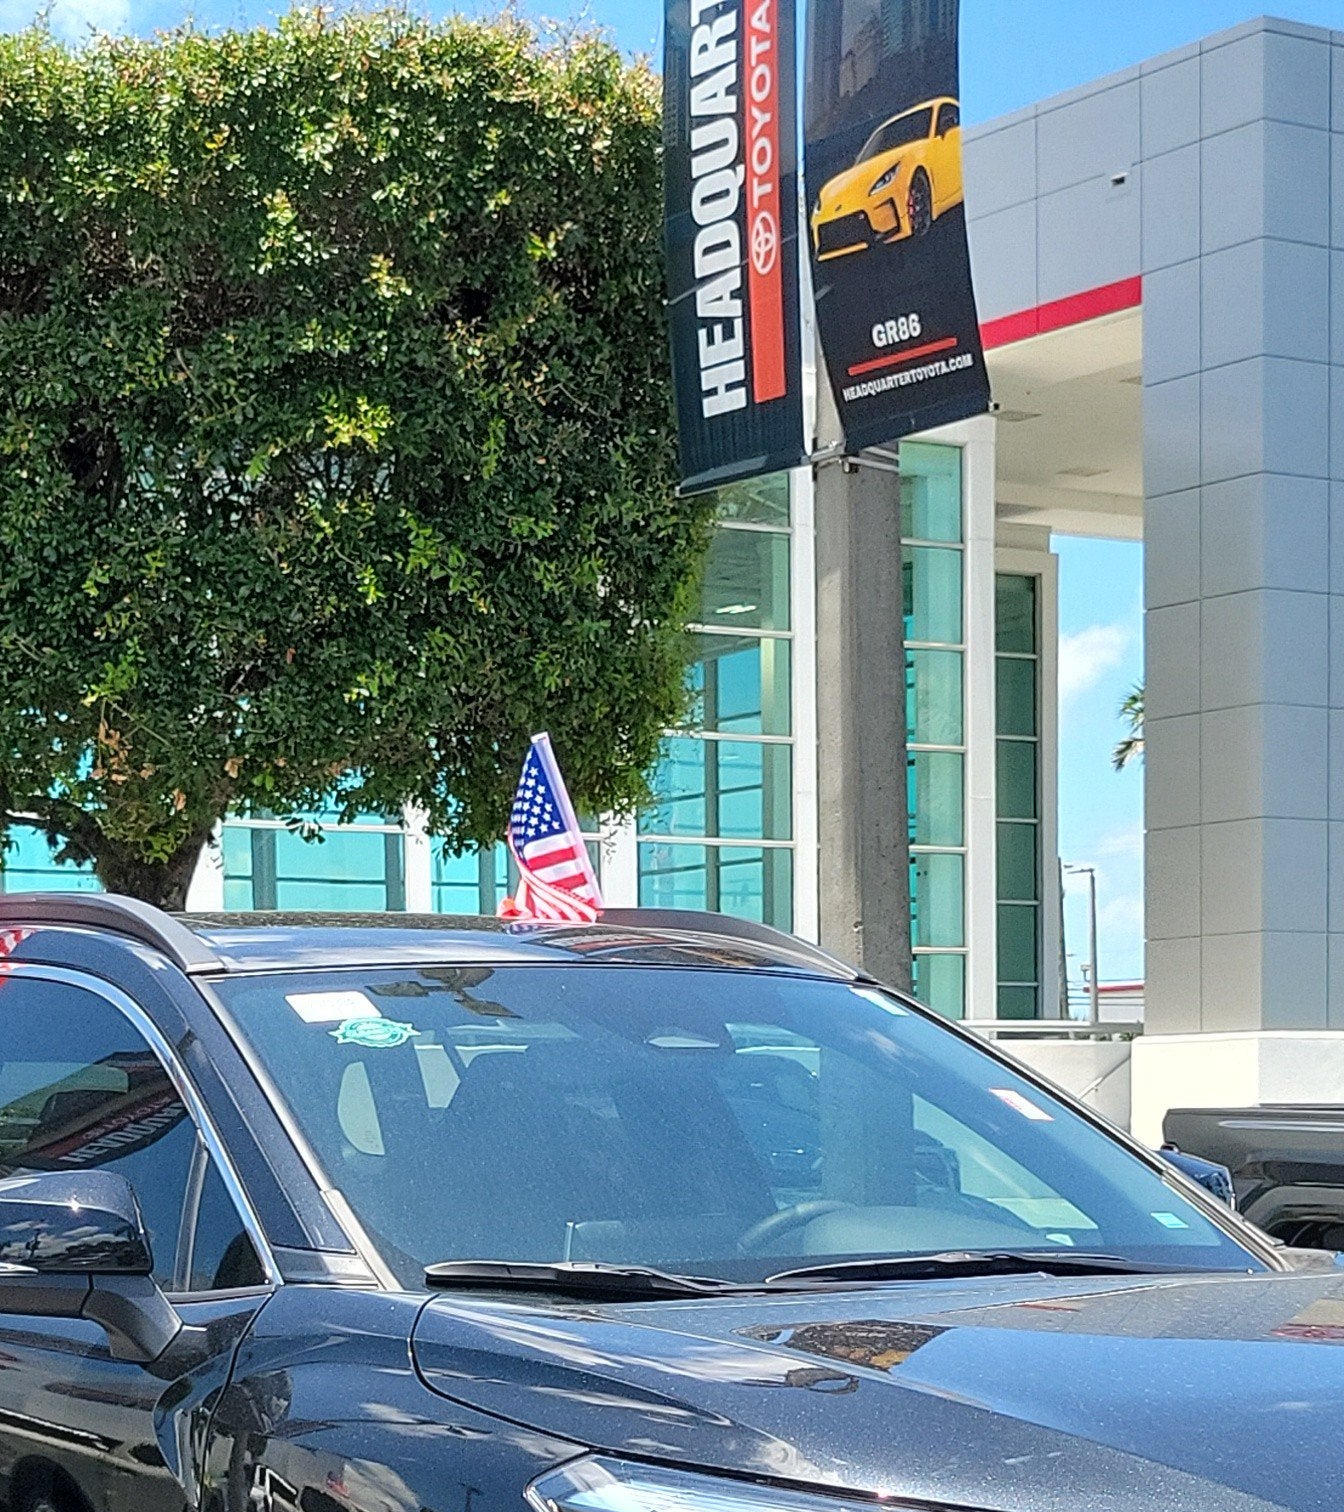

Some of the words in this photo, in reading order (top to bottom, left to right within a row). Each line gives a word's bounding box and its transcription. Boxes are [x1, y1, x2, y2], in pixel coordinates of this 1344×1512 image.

[750, 0, 774, 208] TOYOTA
[871, 313, 922, 348] GR86
[842, 353, 974, 402] HEADQUARTERTOYOTA.COM
